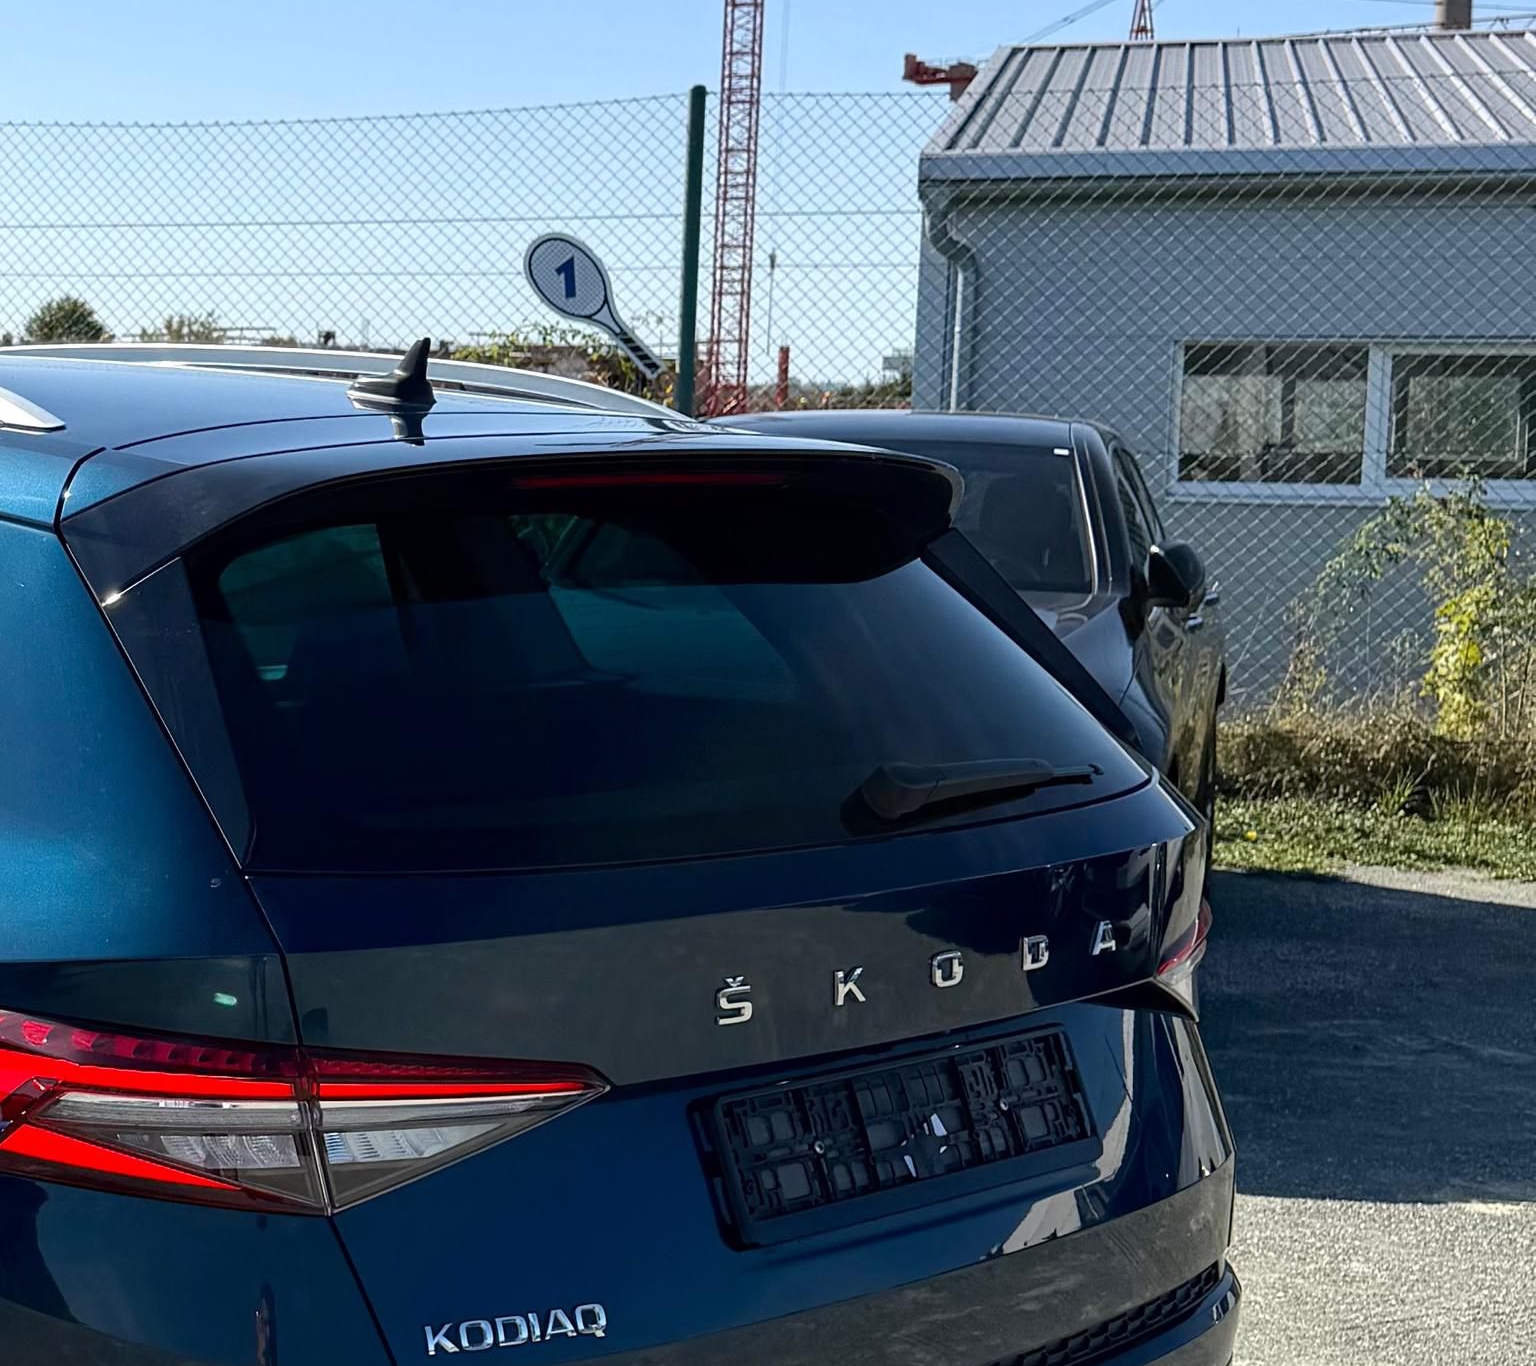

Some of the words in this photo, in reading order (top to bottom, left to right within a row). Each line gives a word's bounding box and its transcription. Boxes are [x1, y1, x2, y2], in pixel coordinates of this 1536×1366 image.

[554, 255, 577, 299] 1
[715, 919, 1117, 1027] ŠKODA
[424, 1303, 607, 1356] KODIAQ
